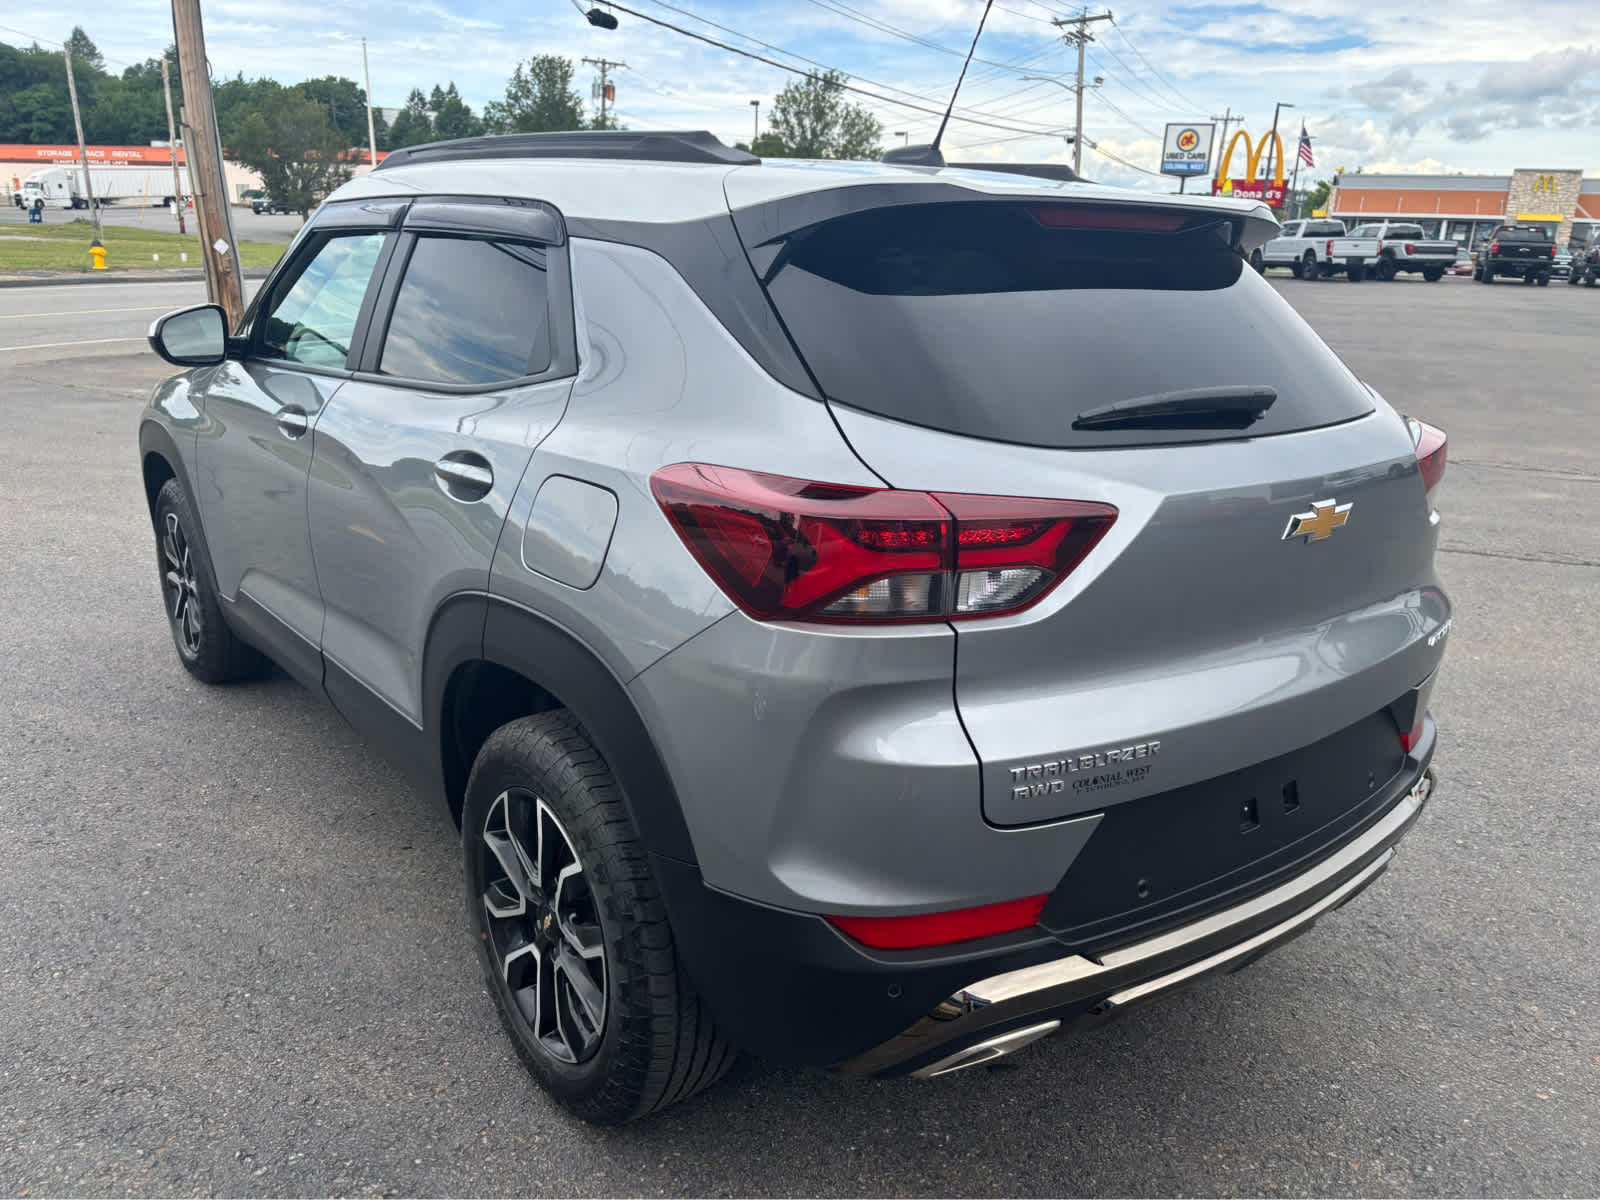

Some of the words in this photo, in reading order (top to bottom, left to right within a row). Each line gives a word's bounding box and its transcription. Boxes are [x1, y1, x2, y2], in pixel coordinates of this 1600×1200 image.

[37, 149, 73, 157] STORAGE
[111, 151, 143, 159] RENTAL
[1166, 152, 1185, 160] USED
[1187, 152, 1206, 160] CARS
[1009, 741, 1161, 782] TRAILBLAZER
[1072, 771, 1122, 790] COLONIAL
[1125, 765, 1152, 779] WEST
[1011, 780, 1065, 801] AWD
